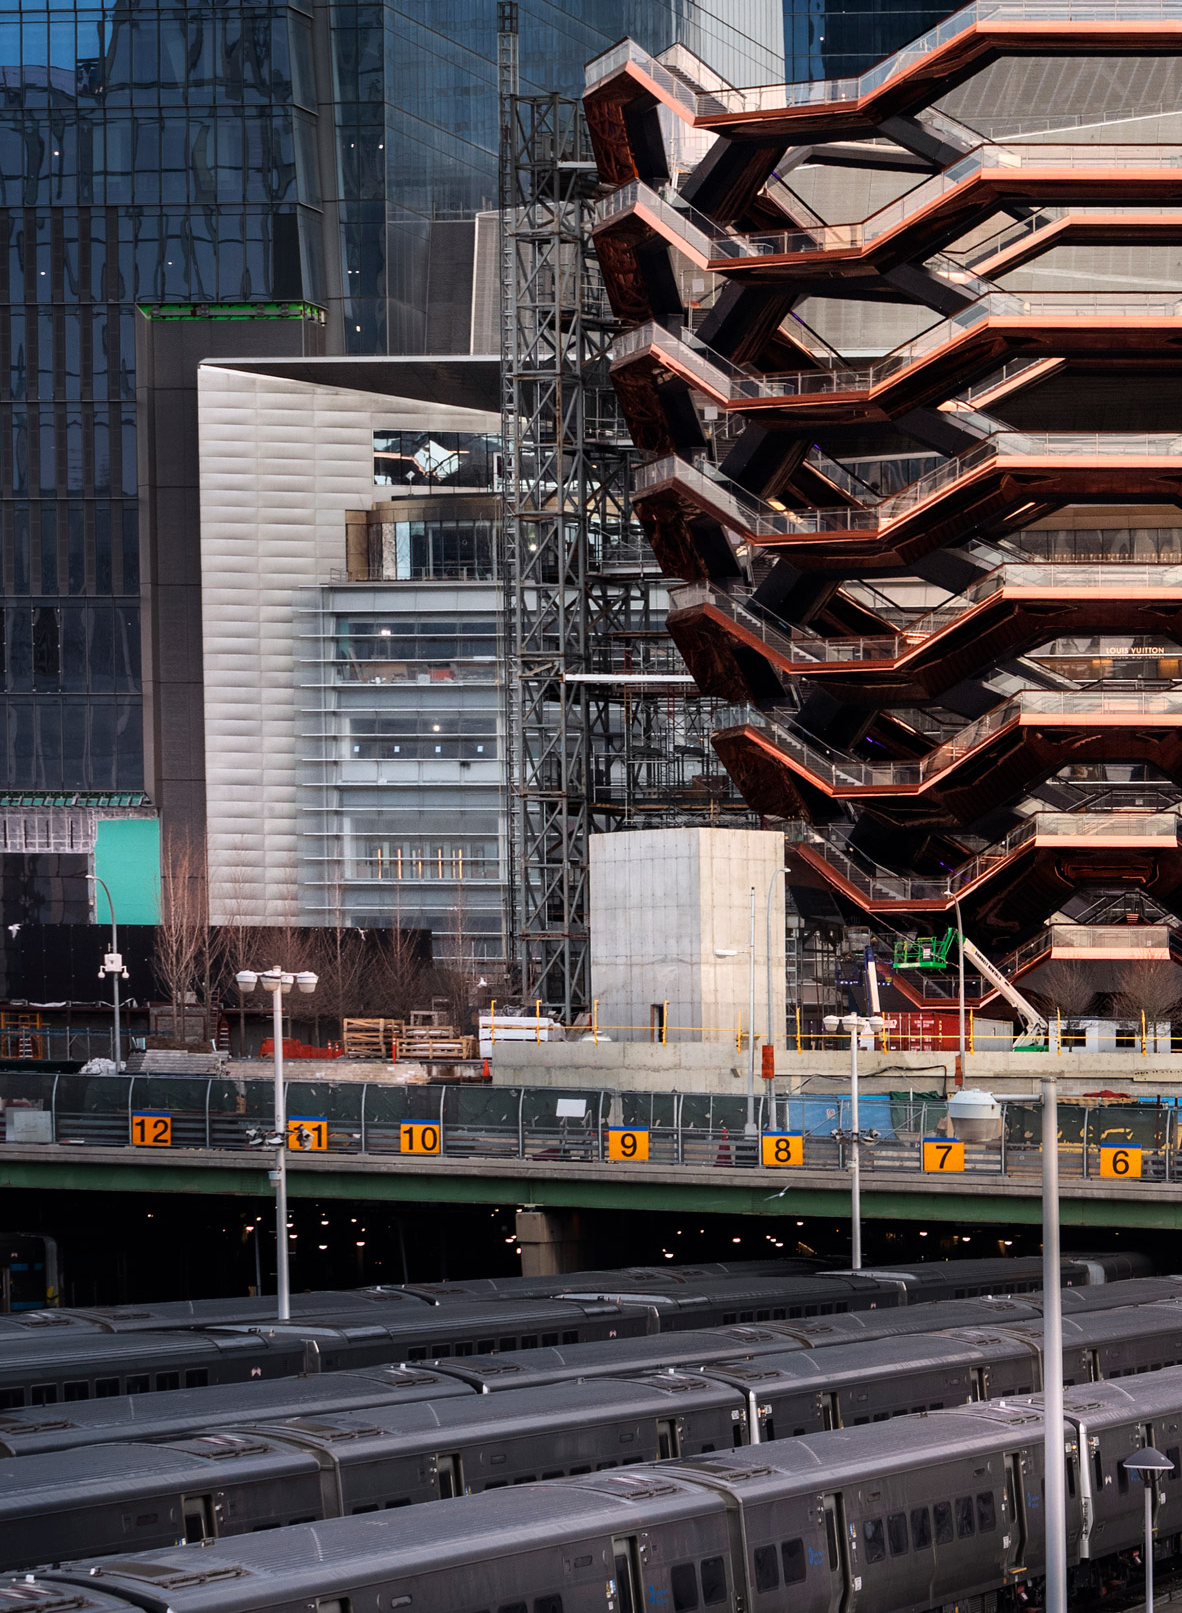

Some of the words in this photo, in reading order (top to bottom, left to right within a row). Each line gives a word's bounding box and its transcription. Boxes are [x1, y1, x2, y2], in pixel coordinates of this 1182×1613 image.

[135, 1119, 167, 1142] 12
[294, 1124, 322, 1147] 11
[403, 1127, 436, 1150] 10
[621, 1133, 637, 1157] 9
[775, 1139, 791, 1162] 8
[936, 1146, 952, 1169] 7
[1113, 1150, 1129, 1174] 6
